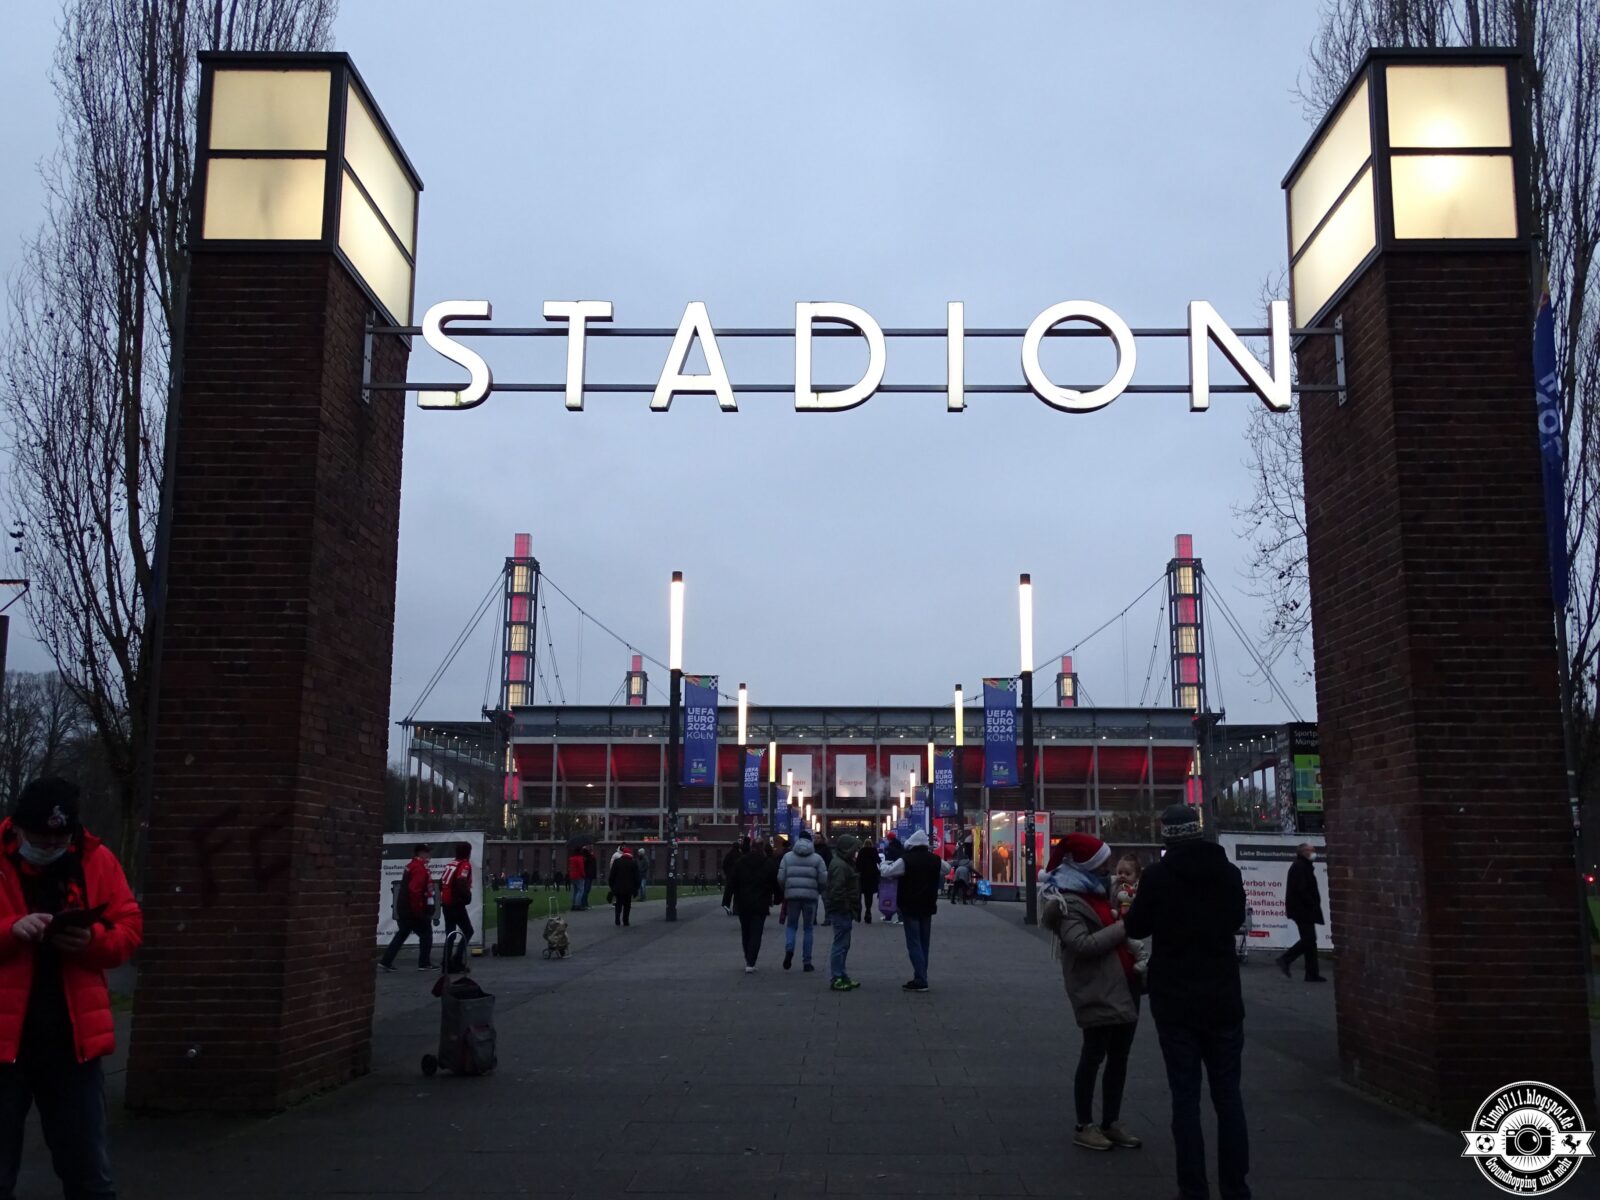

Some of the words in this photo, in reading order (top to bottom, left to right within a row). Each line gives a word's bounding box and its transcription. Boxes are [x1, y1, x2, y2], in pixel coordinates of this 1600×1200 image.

[417, 299, 1292, 414] STADION
[687, 707, 715, 715] UEFA
[986, 709, 1014, 717] UEFA
[687, 715, 715, 723] EURO
[986, 717, 1014, 725] EURO
[687, 723, 714, 731] 2024
[986, 725, 1013, 733] 2024
